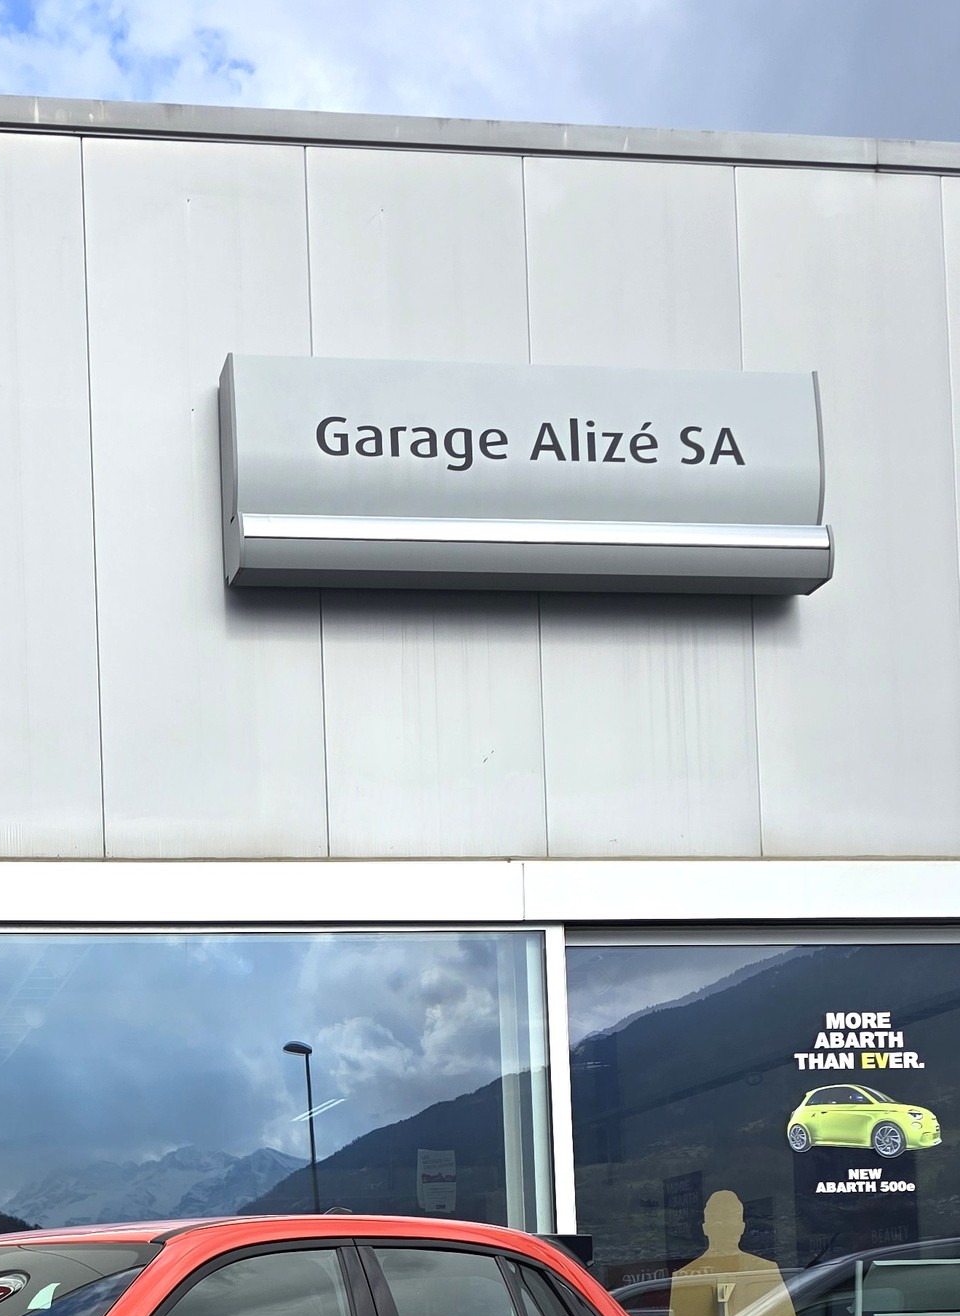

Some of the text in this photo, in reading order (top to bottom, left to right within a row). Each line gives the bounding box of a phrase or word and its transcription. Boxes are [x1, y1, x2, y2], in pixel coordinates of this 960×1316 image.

[315, 416, 747, 472] Garage Alizé SA
[825, 1011, 892, 1030] MORE
[813, 1031, 904, 1049] ABARTH
[793, 1051, 926, 1070] THAN EVER.
[847, 1168, 883, 1181] NEW
[815, 1180, 916, 1194] ABARTH 500e
